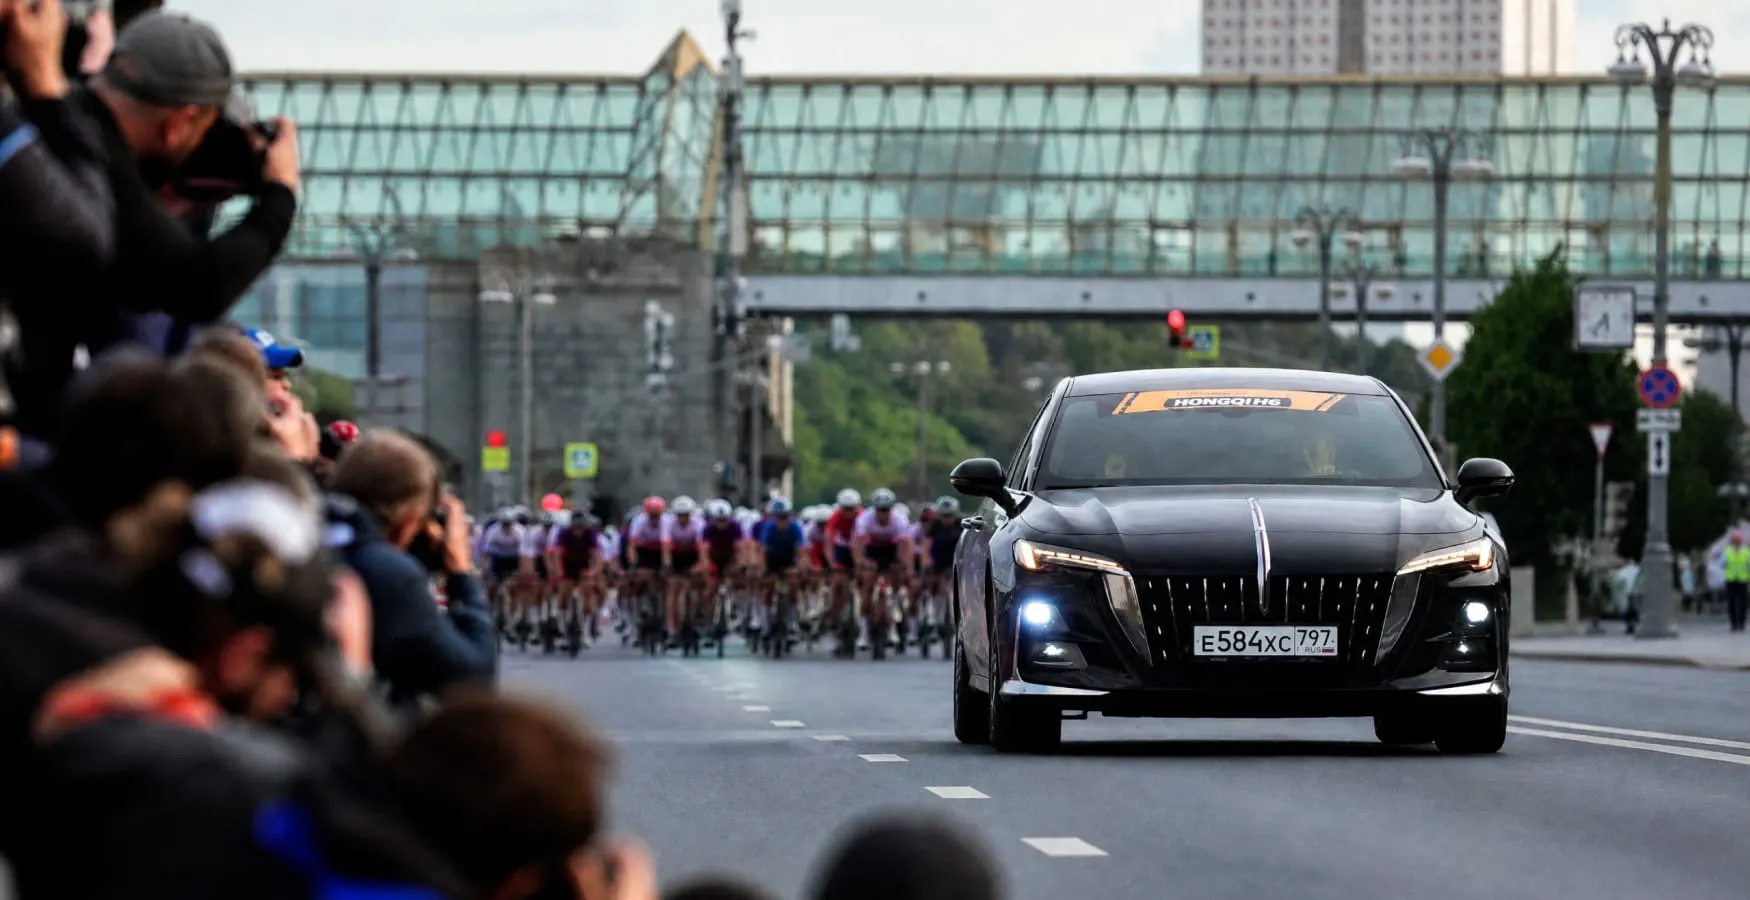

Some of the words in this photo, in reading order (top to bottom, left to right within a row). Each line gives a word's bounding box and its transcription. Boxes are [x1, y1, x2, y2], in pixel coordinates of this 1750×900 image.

[1174, 398, 1252, 407] HONGQI
[1253, 398, 1281, 406] H6
[1297, 629, 1331, 646] 797
